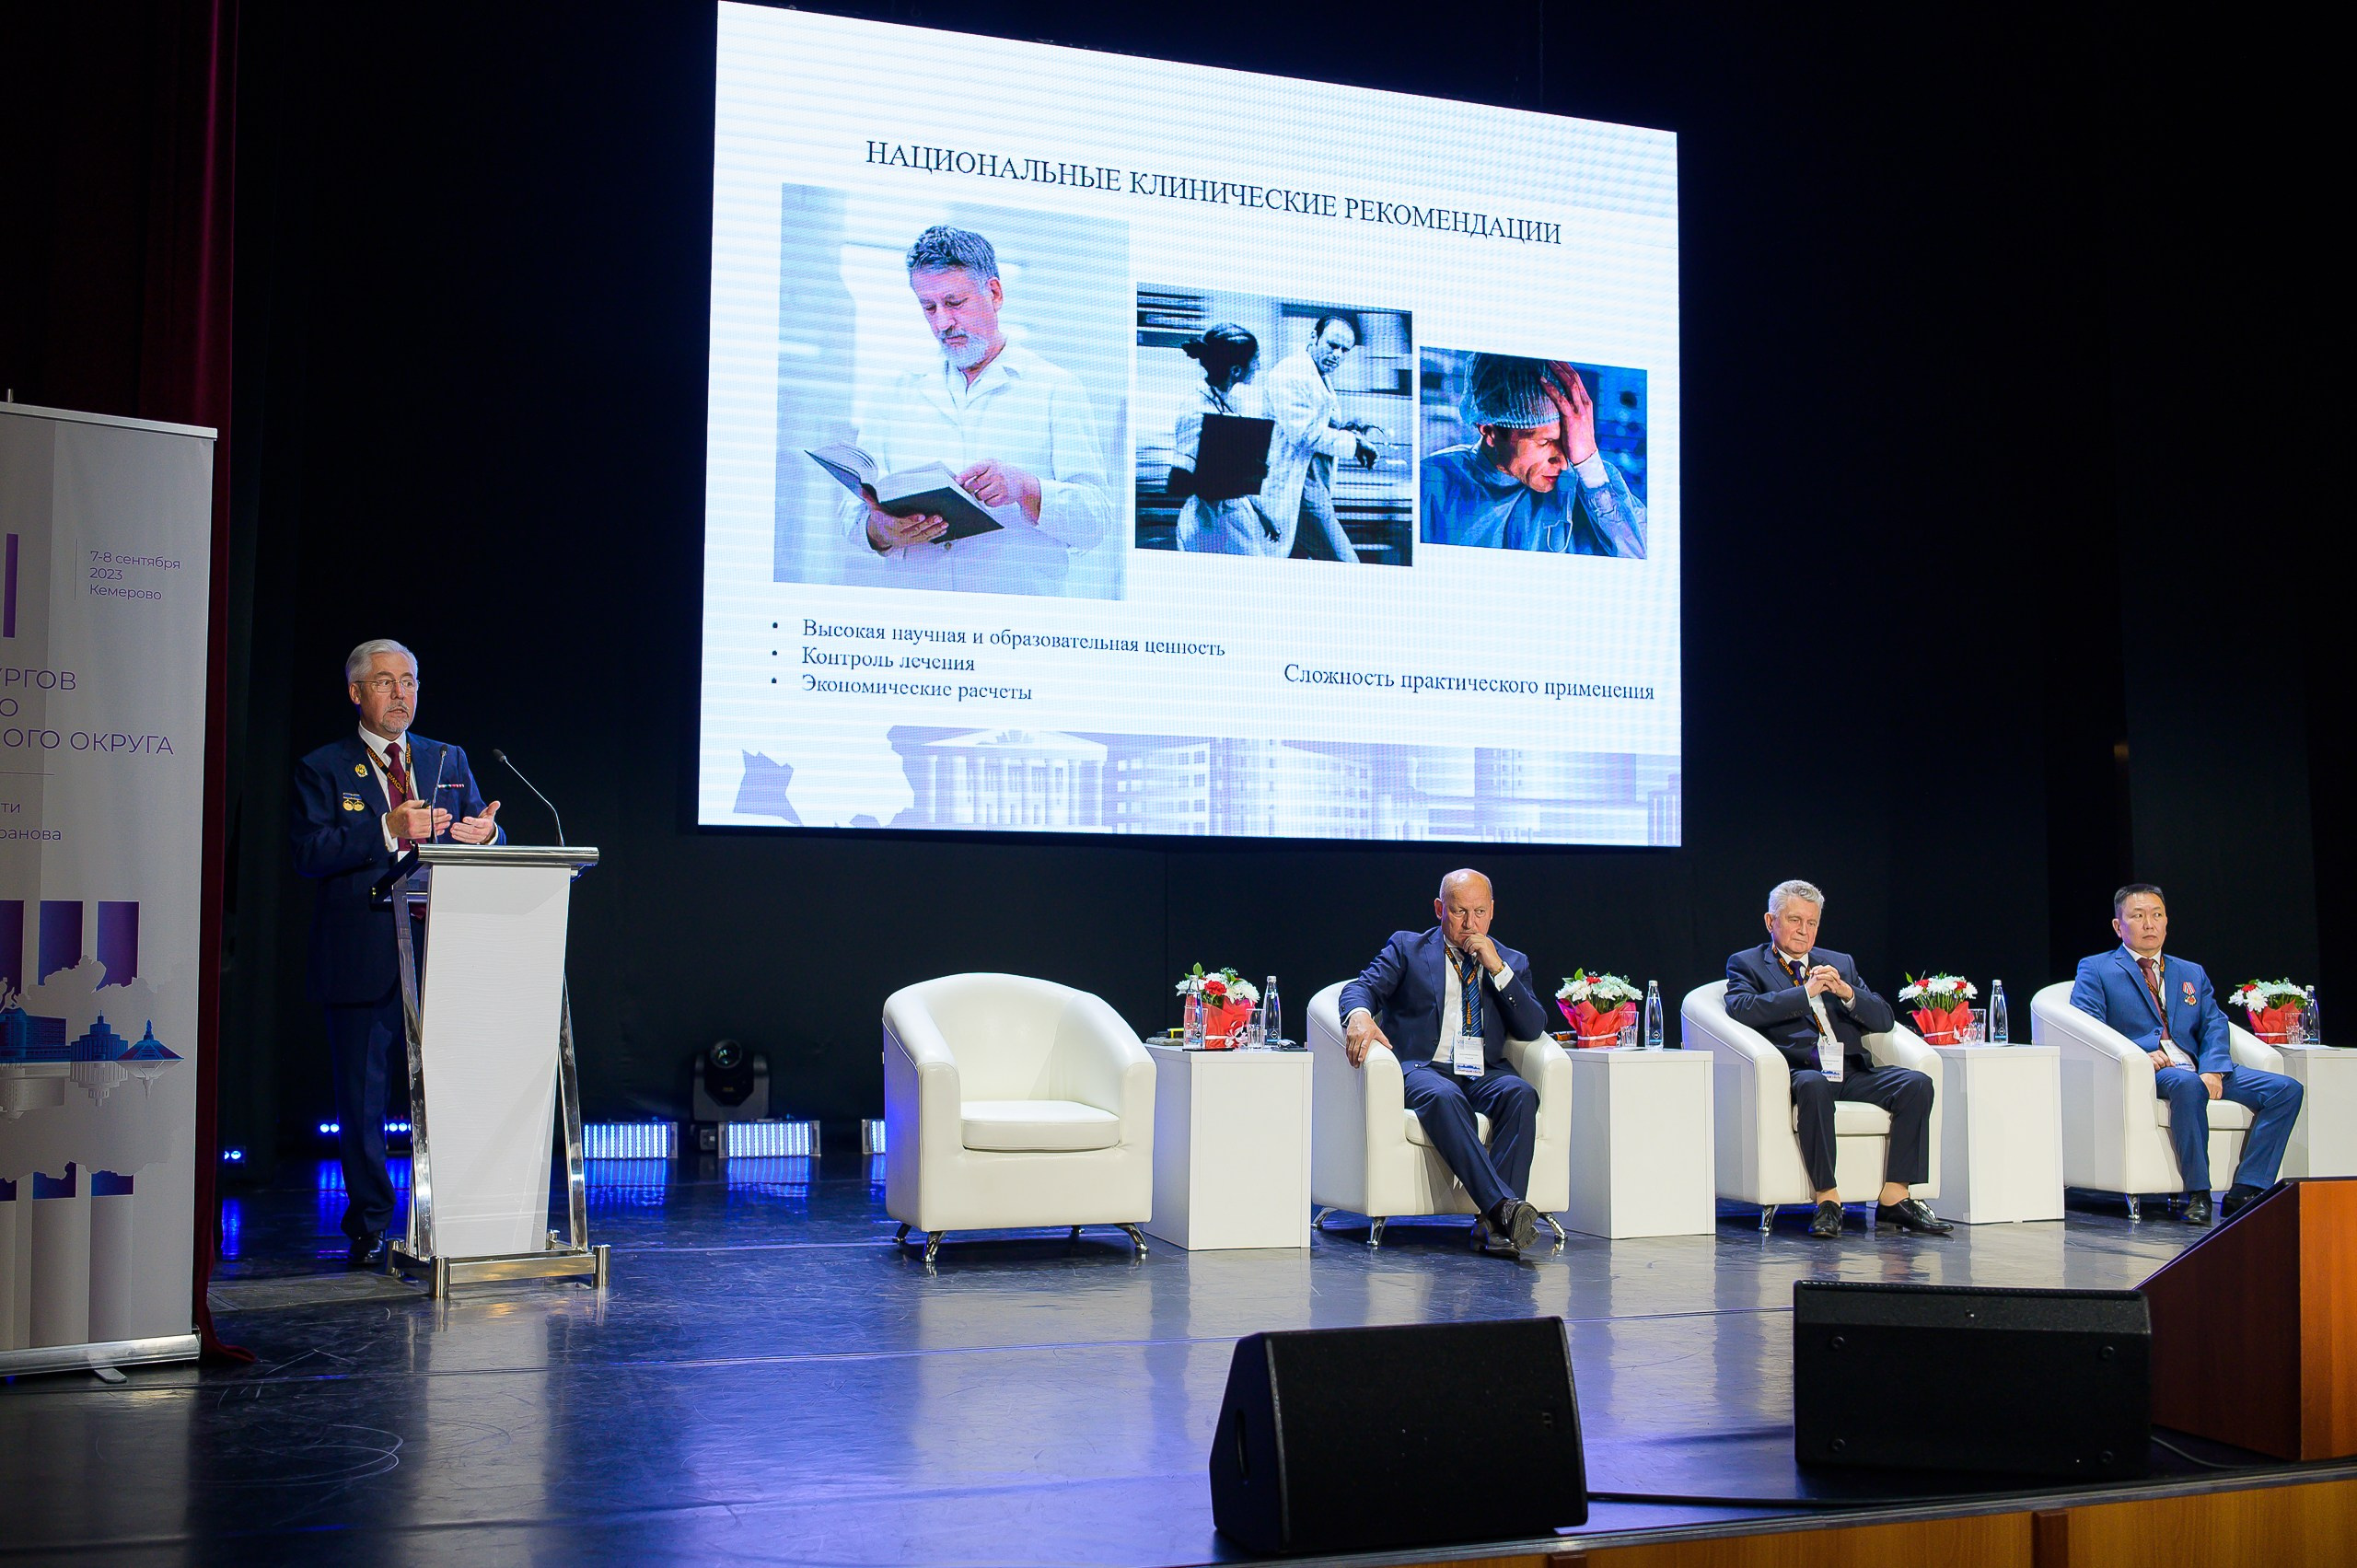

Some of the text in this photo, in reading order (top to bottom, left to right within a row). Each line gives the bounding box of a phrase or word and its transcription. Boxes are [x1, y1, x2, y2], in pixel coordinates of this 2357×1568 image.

[865, 140, 1562, 245] НАЦИОНАЛЬНЫЕ КЛИНИЧЕСКИЕ РЕКОМЕНДАЦИИ
[89, 567, 122, 581] 2023
[90, 551, 180, 571] 7-8 сентября
[89, 584, 162, 600] Кемерово
[802, 619, 1226, 656] Высокая научная и образовательная ценность
[802, 646, 975, 671] Контроль лечения
[802, 674, 1033, 702] Экономические расчеты
[1283, 663, 1655, 701] Сложность практического применения
[3, 728, 174, 755] ОГО ОКРУГА
